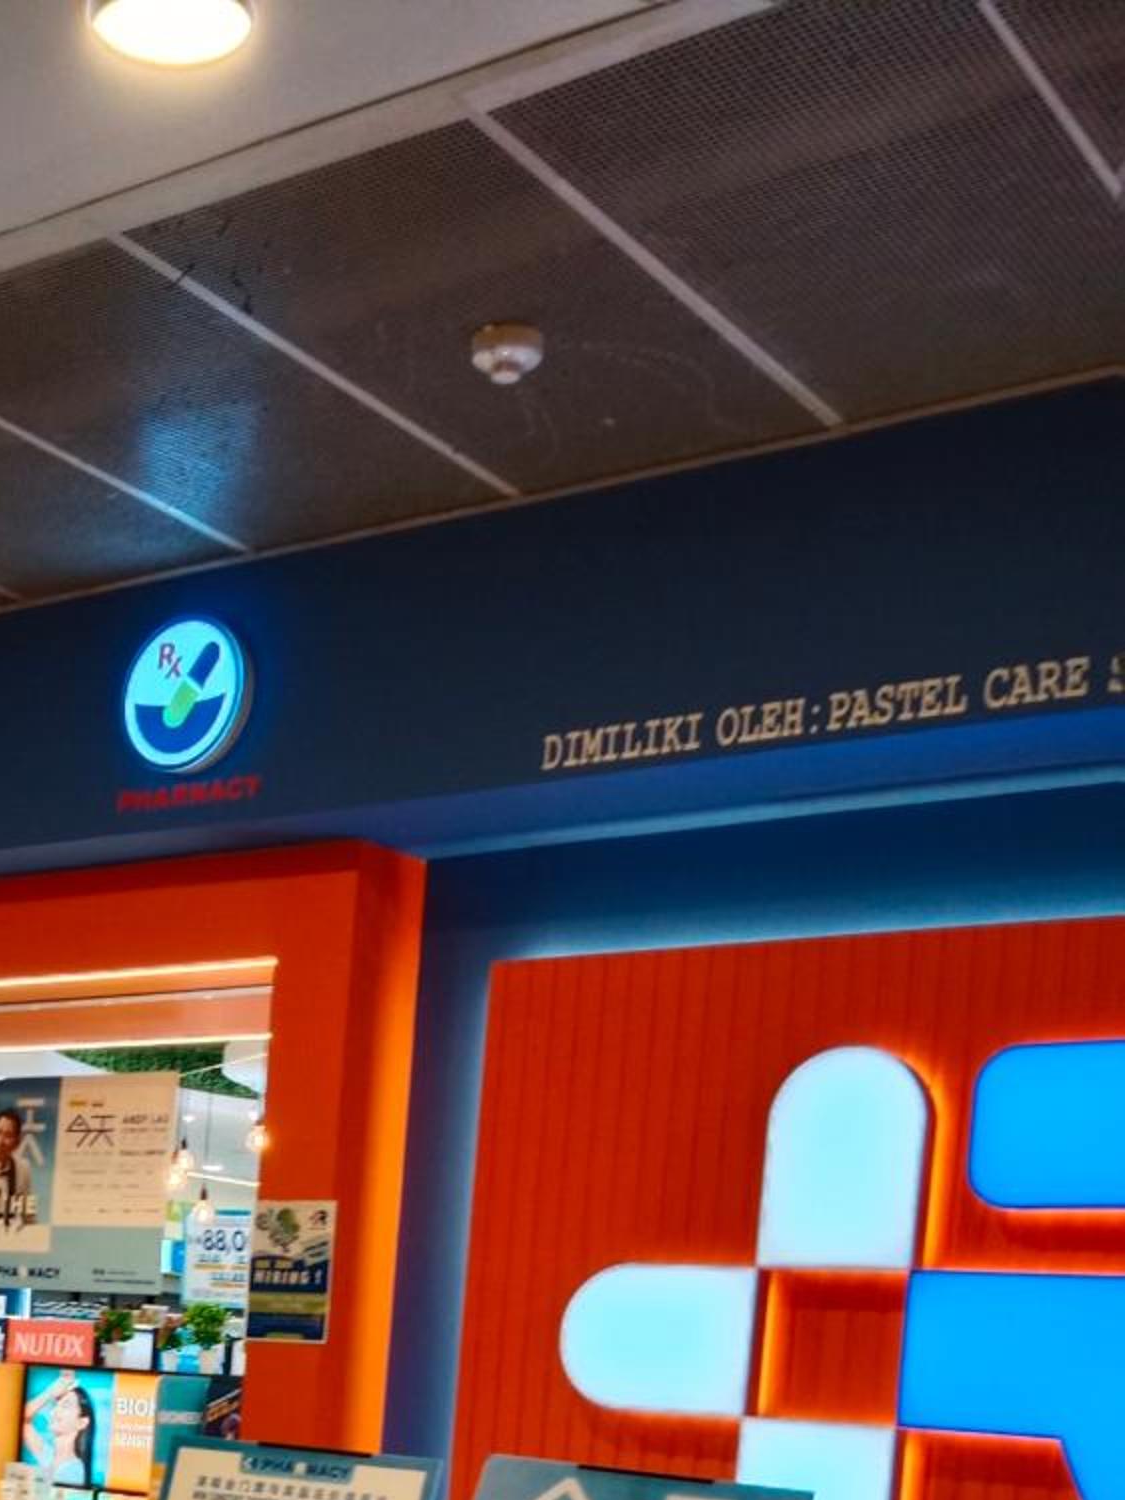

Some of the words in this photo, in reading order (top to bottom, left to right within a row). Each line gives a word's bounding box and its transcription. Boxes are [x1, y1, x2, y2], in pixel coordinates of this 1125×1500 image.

[541, 712, 704, 770] DIMILIKI
[984, 656, 1091, 711] CARE
[14, 1331, 86, 1360] NUTOX
